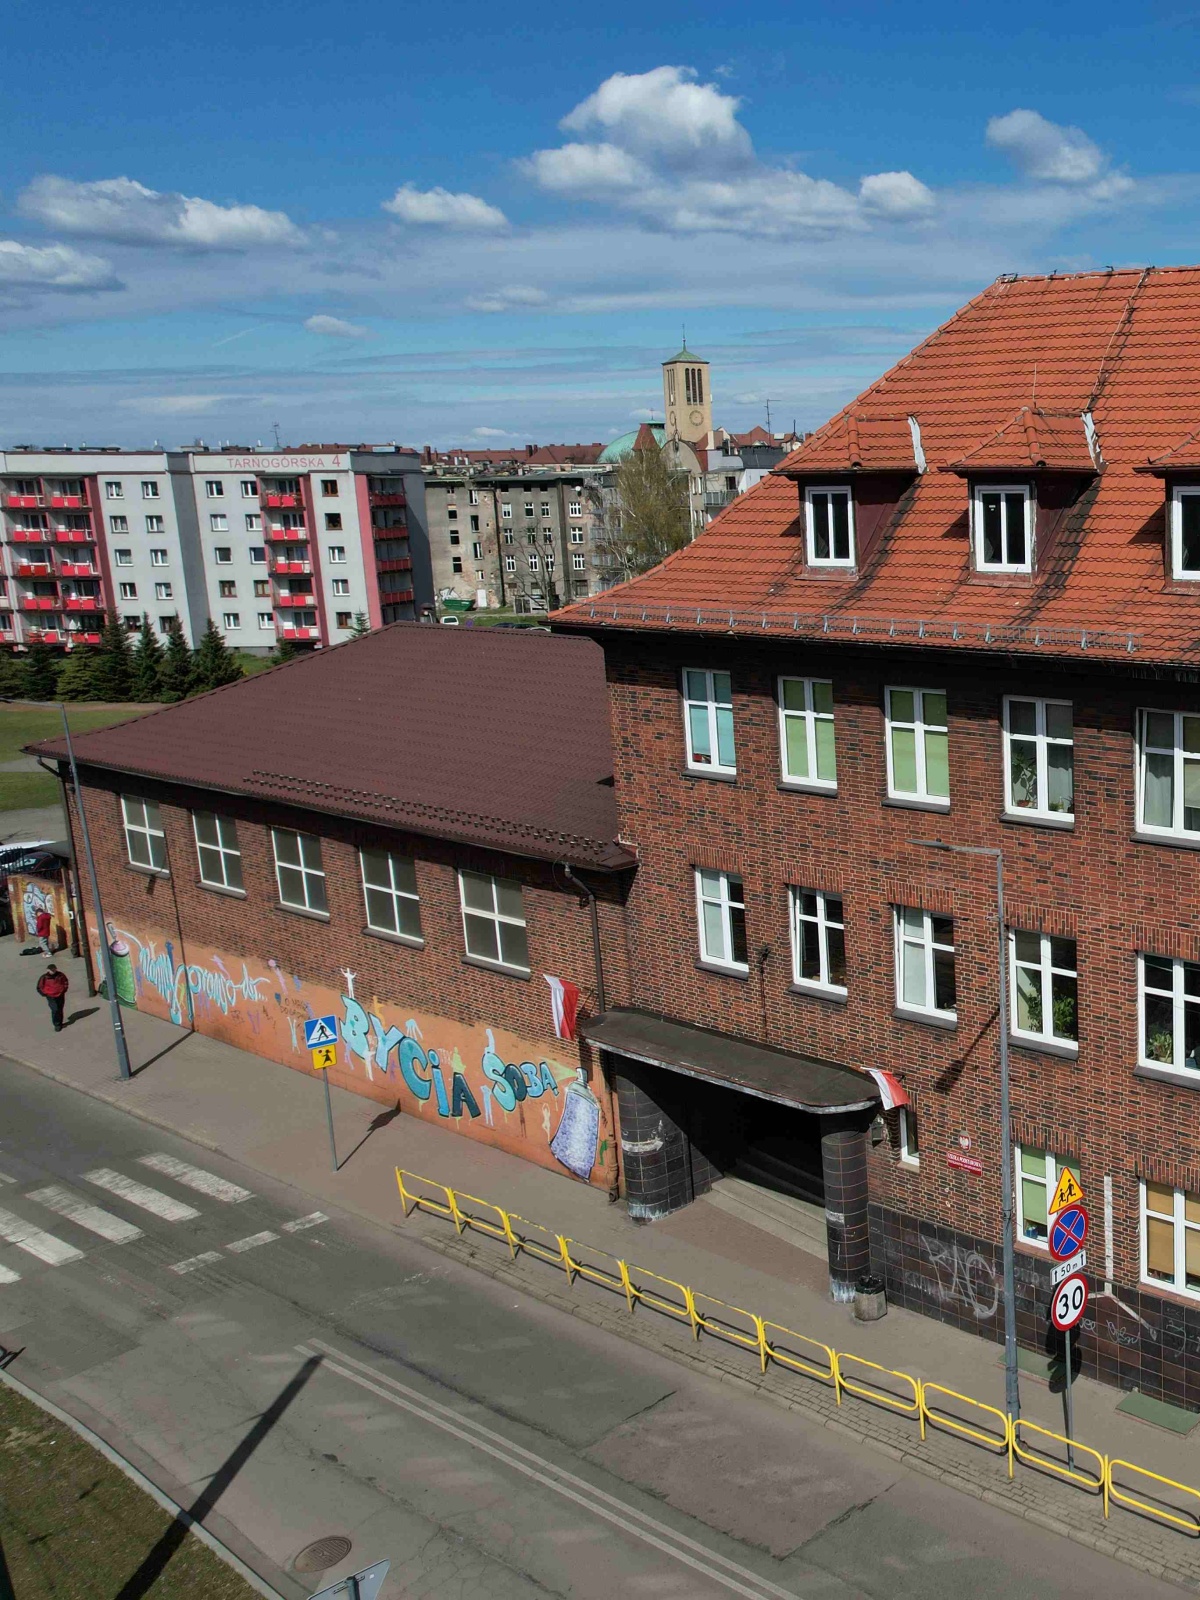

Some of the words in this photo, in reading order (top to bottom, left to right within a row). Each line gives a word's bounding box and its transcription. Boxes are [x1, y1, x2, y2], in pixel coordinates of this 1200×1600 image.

[227, 456, 325, 468] TARNOGÓRSKA
[332, 454, 341, 468] 4
[1061, 1263, 1071, 1277] 50
[1072, 1262, 1077, 1270] m
[1058, 1285, 1083, 1320] 30
